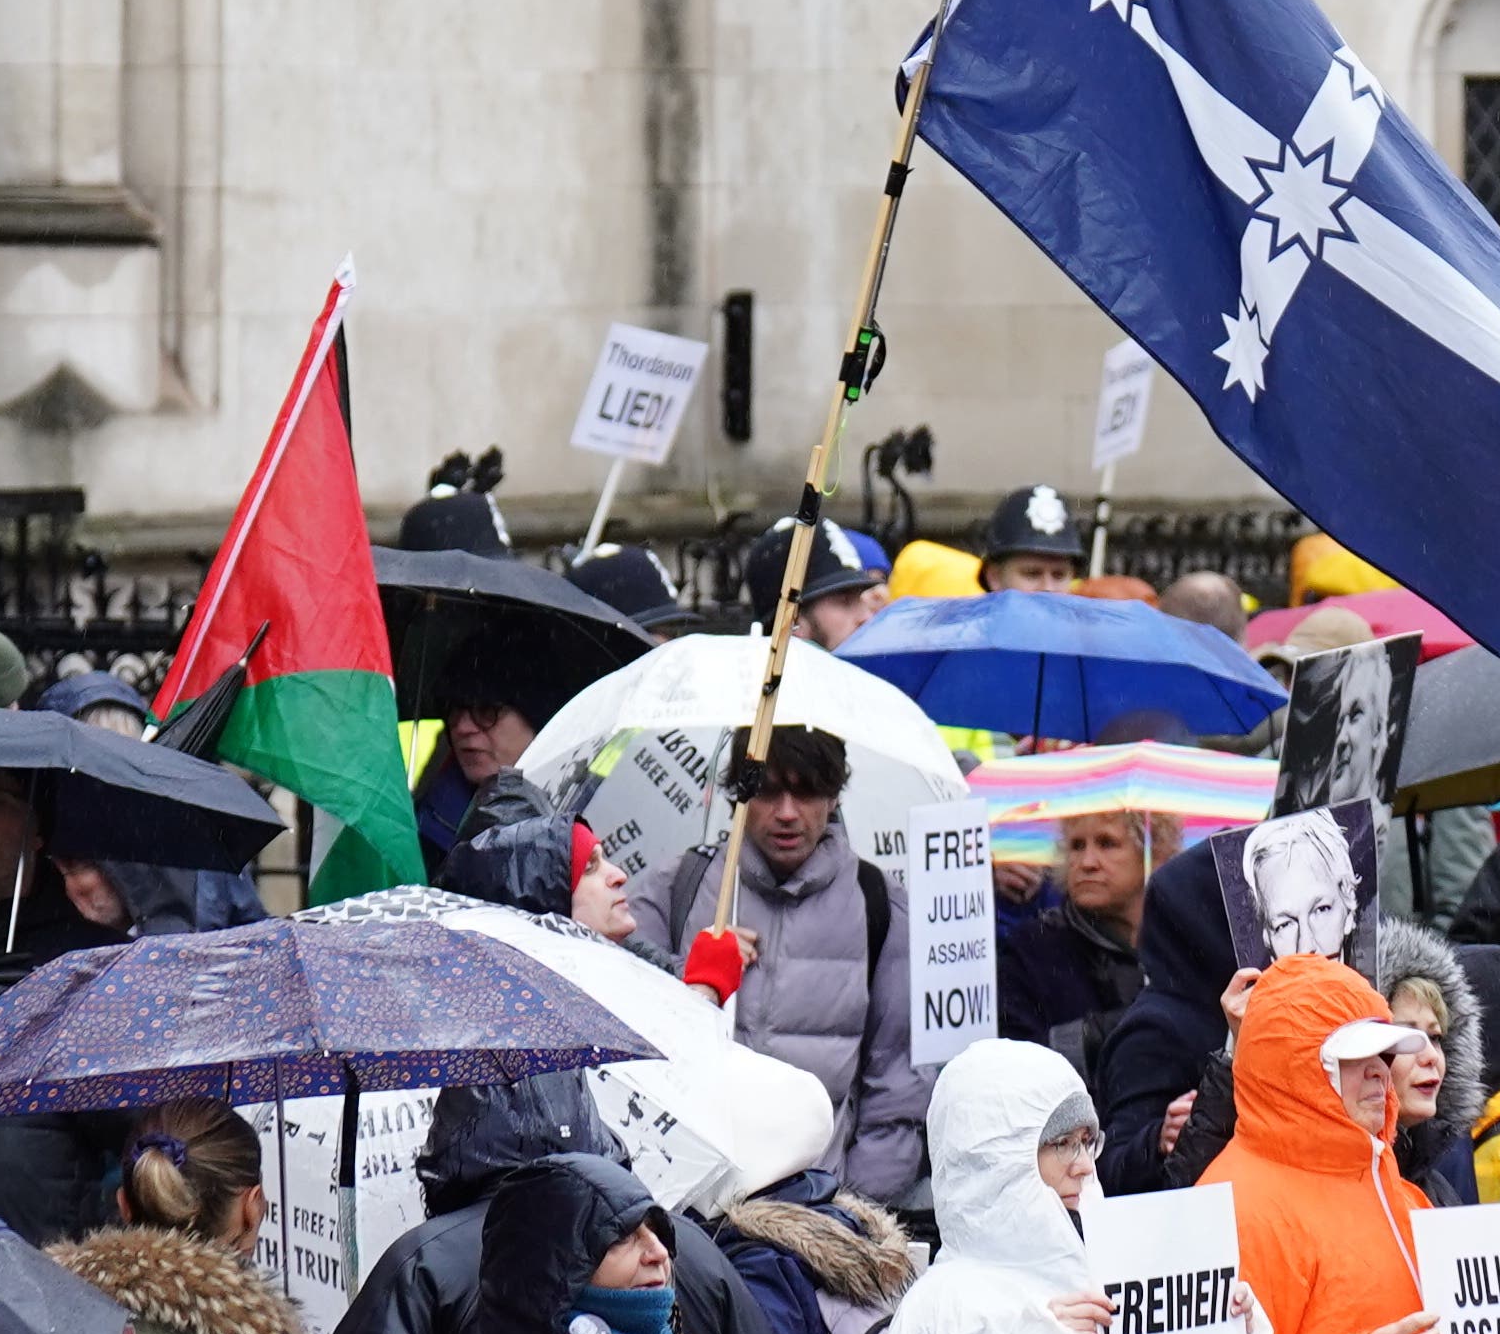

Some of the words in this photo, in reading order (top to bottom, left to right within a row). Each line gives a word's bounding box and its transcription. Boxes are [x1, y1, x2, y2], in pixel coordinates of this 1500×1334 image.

[597, 382, 674, 431] LIED!
[925, 827, 985, 871] FREE
[928, 890, 986, 923] JULIAN
[927, 939, 987, 965] ASSANGE
[925, 984, 990, 1030] NOW!
[293, 1206, 326, 1240] FREE
